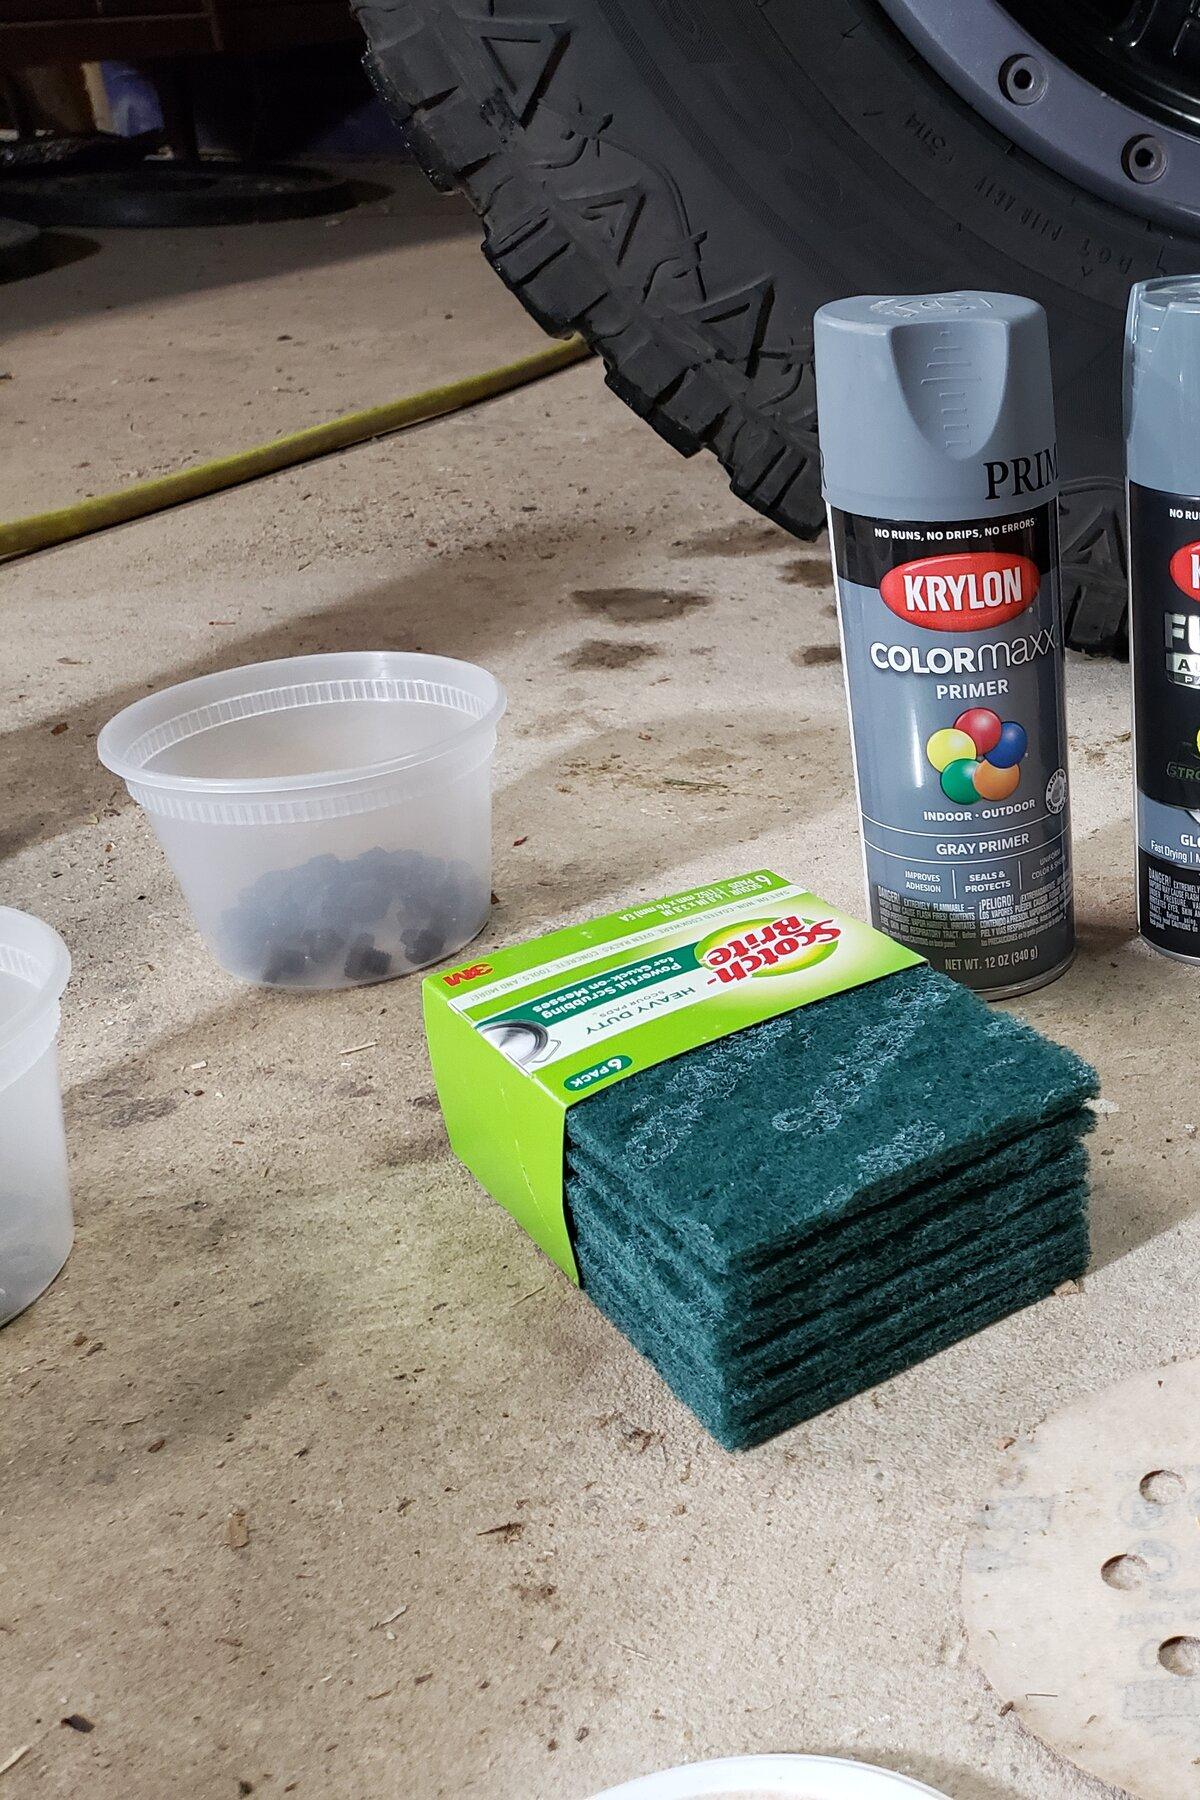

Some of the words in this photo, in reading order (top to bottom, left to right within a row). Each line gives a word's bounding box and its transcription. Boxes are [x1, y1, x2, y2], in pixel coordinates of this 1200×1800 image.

[1169, 508, 1184, 518] NO
[874, 528, 890, 539] NO
[891, 529, 924, 541] RUNS,
[926, 530, 944, 541] NO
[946, 529, 982, 540] DRIPS,
[984, 526, 1000, 537] NO
[903, 566, 1022, 612] KRYLON
[936, 679, 1009, 700] PRIMER
[923, 811, 973, 822] INDOOR
[981, 799, 1036, 820] OUTDOOR
[936, 843, 976, 855] GRAY
[979, 833, 1030, 853] PRIMER
[1151, 840, 1164, 855] Fast
[1164, 846, 1188, 864] Drying
[754, 874, 773, 886] 6
[904, 870, 941, 883] IMPROVES
[965, 880, 1011, 893] PROTECTS
[969, 872, 997, 882] SEALS
[998, 870, 1006, 879] &
[1173, 880, 1200, 893] EXTREMELY
[905, 881, 941, 893] ADHESION
[1185, 891, 1200, 902] FLASH
[933, 902, 965, 912] FLAMMABLE
[701, 915, 801, 968] Brite
[653, 956, 675, 968] for
[705, 919, 842, 987] Scotch-
[944, 958, 963, 971] NET
[963, 957, 982, 971] WT.
[984, 956, 995, 970] 12
[997, 954, 1010, 967] OZ
[1011, 948, 1028, 967] (340
[1028, 945, 1038, 961] g)
[441, 962, 495, 987] 3M
[589, 964, 653, 993] Stuck-on
[615, 962, 683, 991] Powerful
[532, 987, 589, 1014] Messes
[541, 986, 616, 1020] Scrubbing
[629, 989, 666, 1006] SCOUR
[636, 987, 696, 1014] HEAVY
[599, 1003, 628, 1018] PADS
[585, 1011, 633, 1035] DUTY
[607, 1058, 622, 1072] 6
[569, 1065, 610, 1089] PACK
